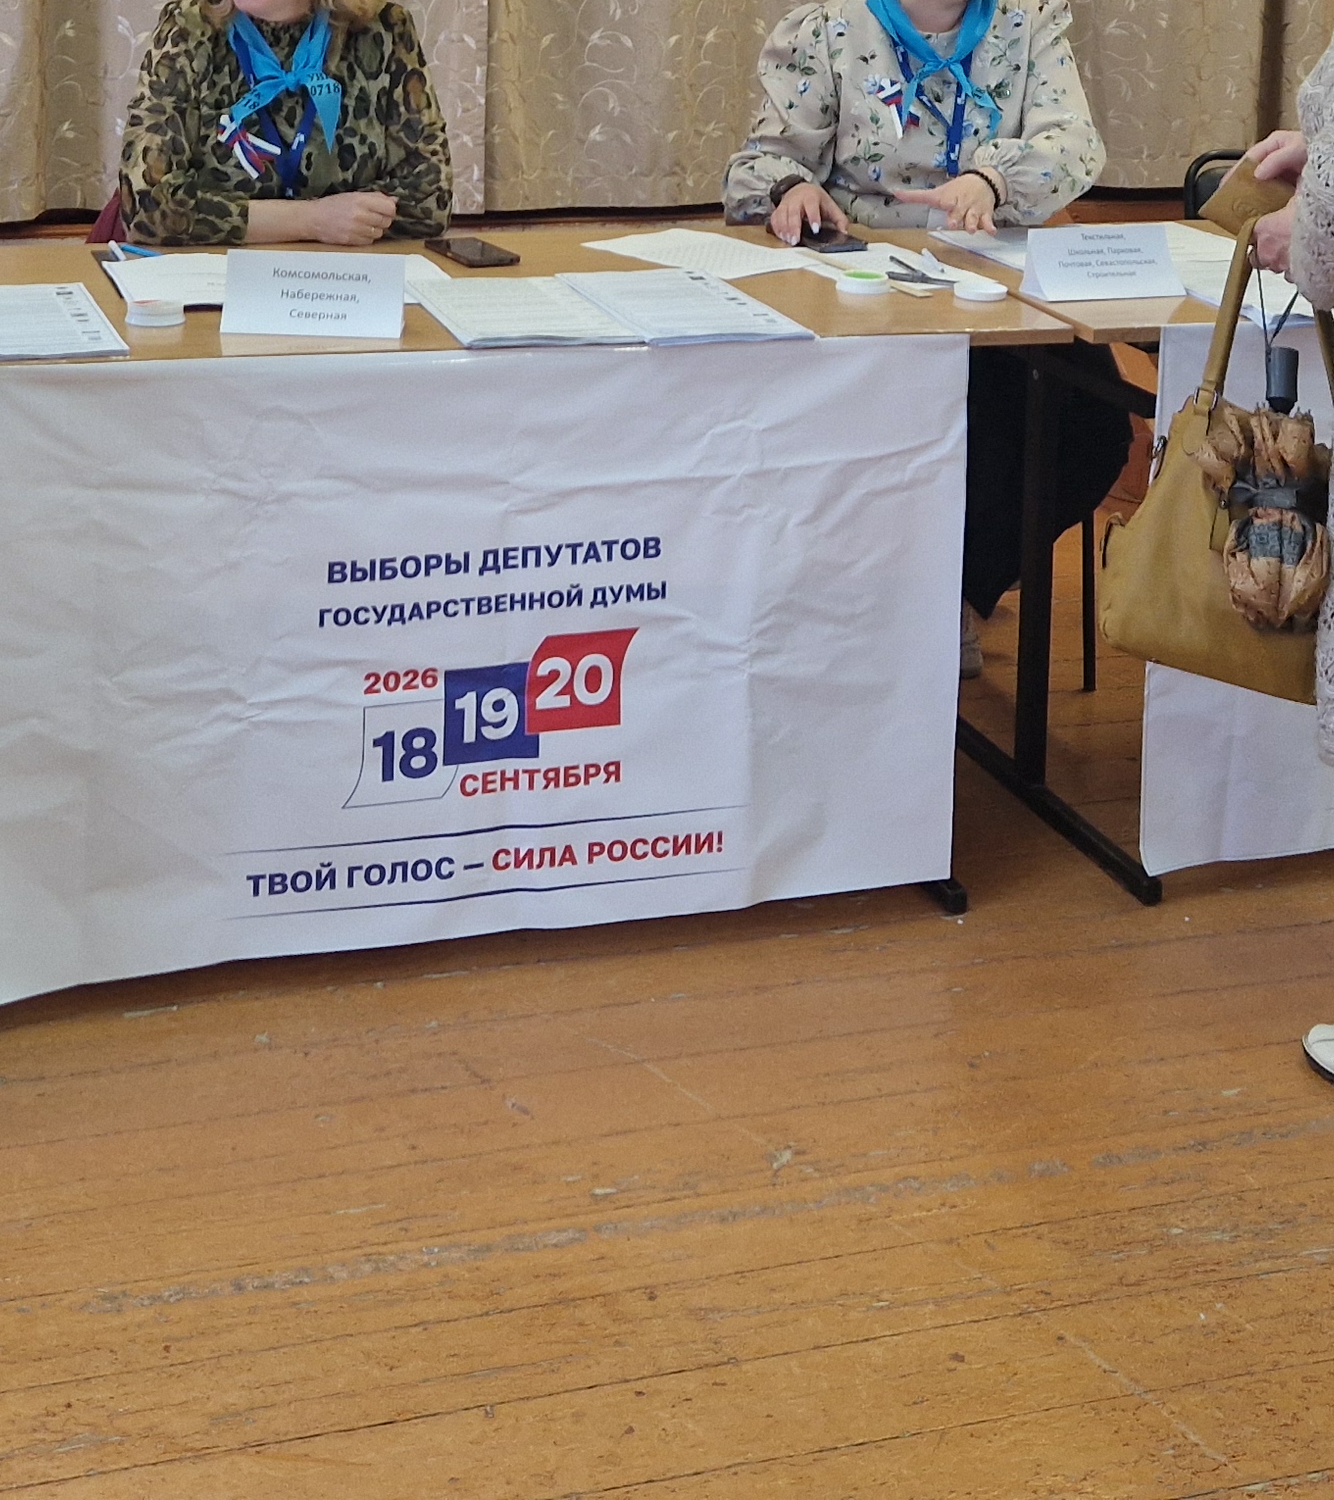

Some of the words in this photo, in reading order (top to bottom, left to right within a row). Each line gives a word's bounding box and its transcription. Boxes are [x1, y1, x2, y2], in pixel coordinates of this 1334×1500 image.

[272, 267, 372, 284] Комсомольская,
[280, 288, 360, 304] Набережная,
[289, 308, 348, 322] Северная
[327, 550, 470, 585] ВЫБОРЫ
[478, 536, 662, 577] ДЕПУТАТОВ
[318, 583, 583, 628] ГОСУДАРСТВЕННОЙ
[589, 580, 667, 609] ДУМЫ
[363, 668, 439, 696] 2026
[372, 726, 439, 783] 18
[455, 687, 519, 744] 19
[534, 653, 614, 711] 20
[459, 760, 622, 798] СЕНТЯБРЯ
[245, 861, 337, 897] ТВОЙ
[346, 856, 455, 888] ГОЛОС
[491, 844, 578, 872] СИЛА
[587, 831, 724, 864] РОССИИ!
